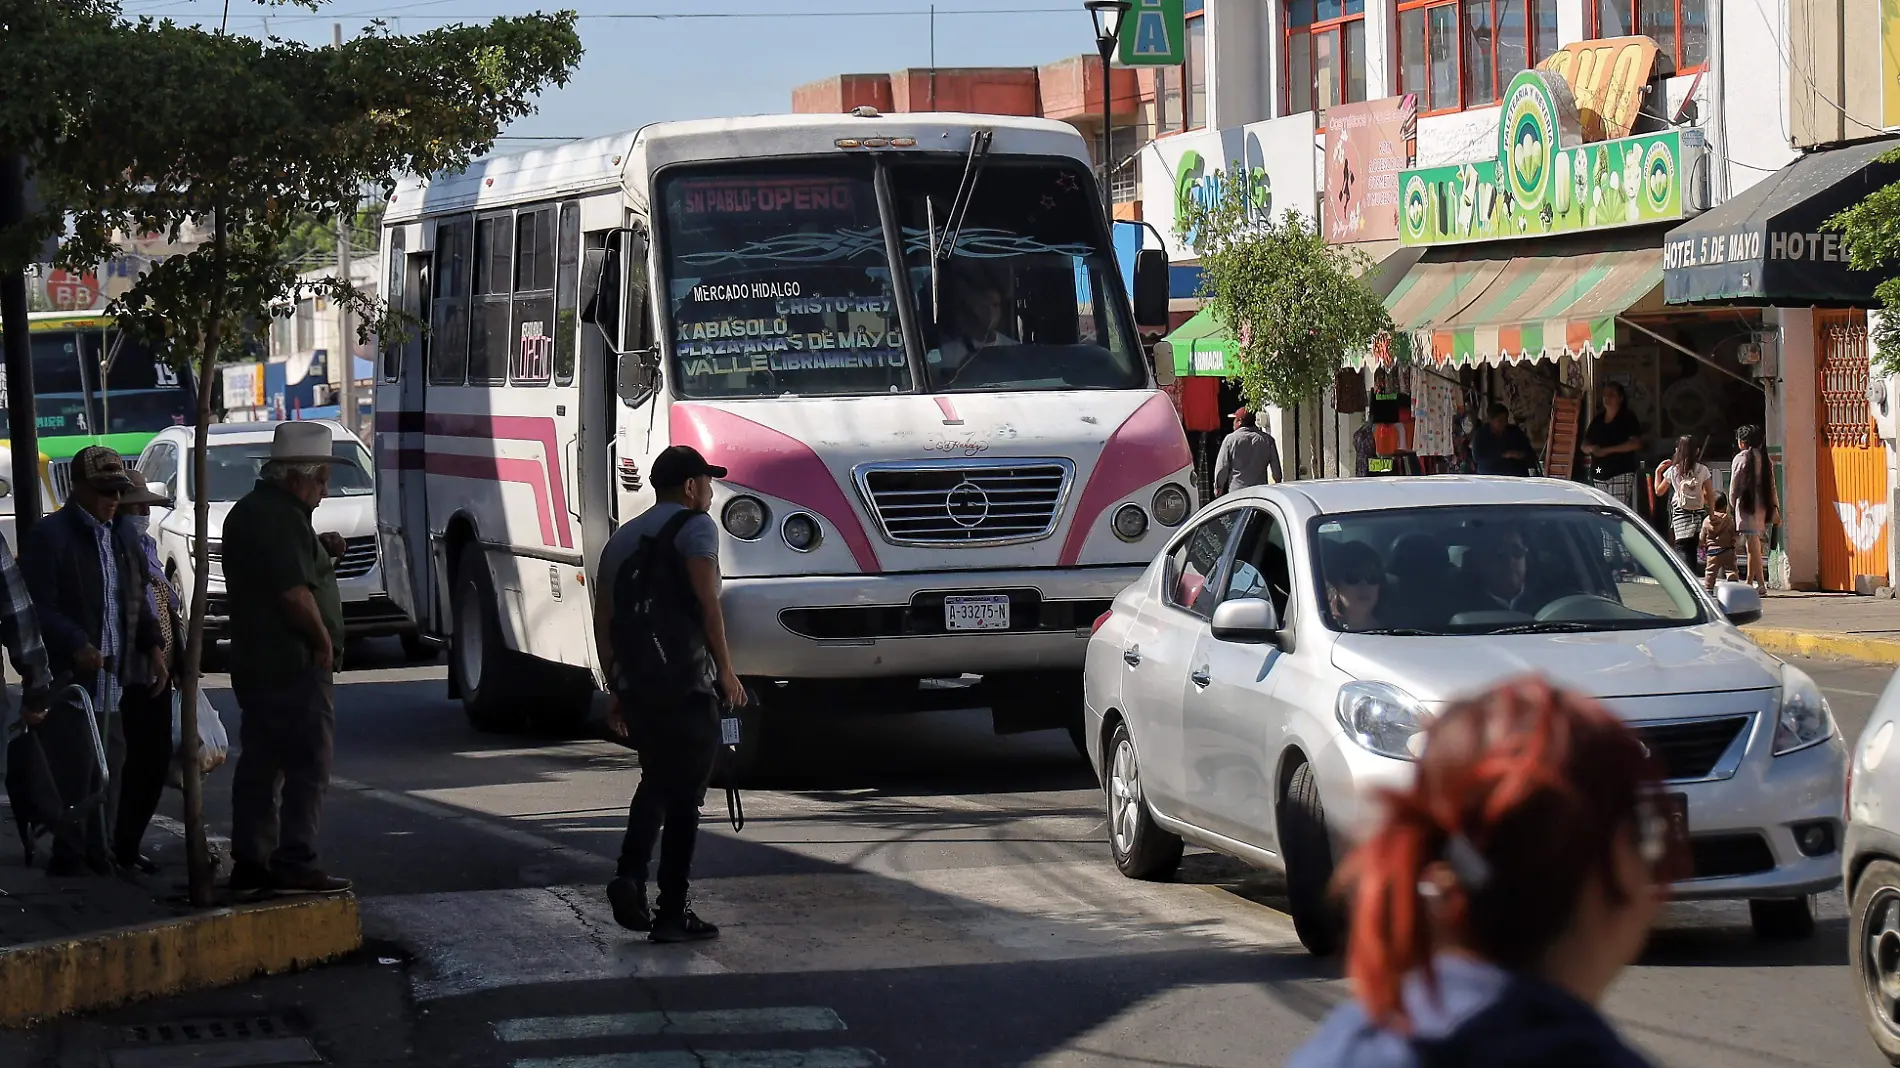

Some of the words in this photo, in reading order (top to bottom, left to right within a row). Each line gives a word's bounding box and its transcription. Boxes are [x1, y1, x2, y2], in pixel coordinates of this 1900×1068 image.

[1663, 239, 1697, 269] HOTEL
[1700, 238, 1707, 263] 5
[1710, 235, 1724, 263] DE
[1728, 231, 1760, 262] MAYO
[693, 283, 749, 303] MERCADO
[751, 281, 801, 299] HIDALGO
[692, 317, 788, 340] ABASOLO
[808, 332, 836, 351] DE
[839, 330, 903, 350] MAYO
[683, 354, 769, 377] VALLE
[769, 350, 906, 372] LIBRAMIENTO
[1190, 351, 1224, 371] FARMACIA
[949, 604, 1006, 620] A-33275-N
